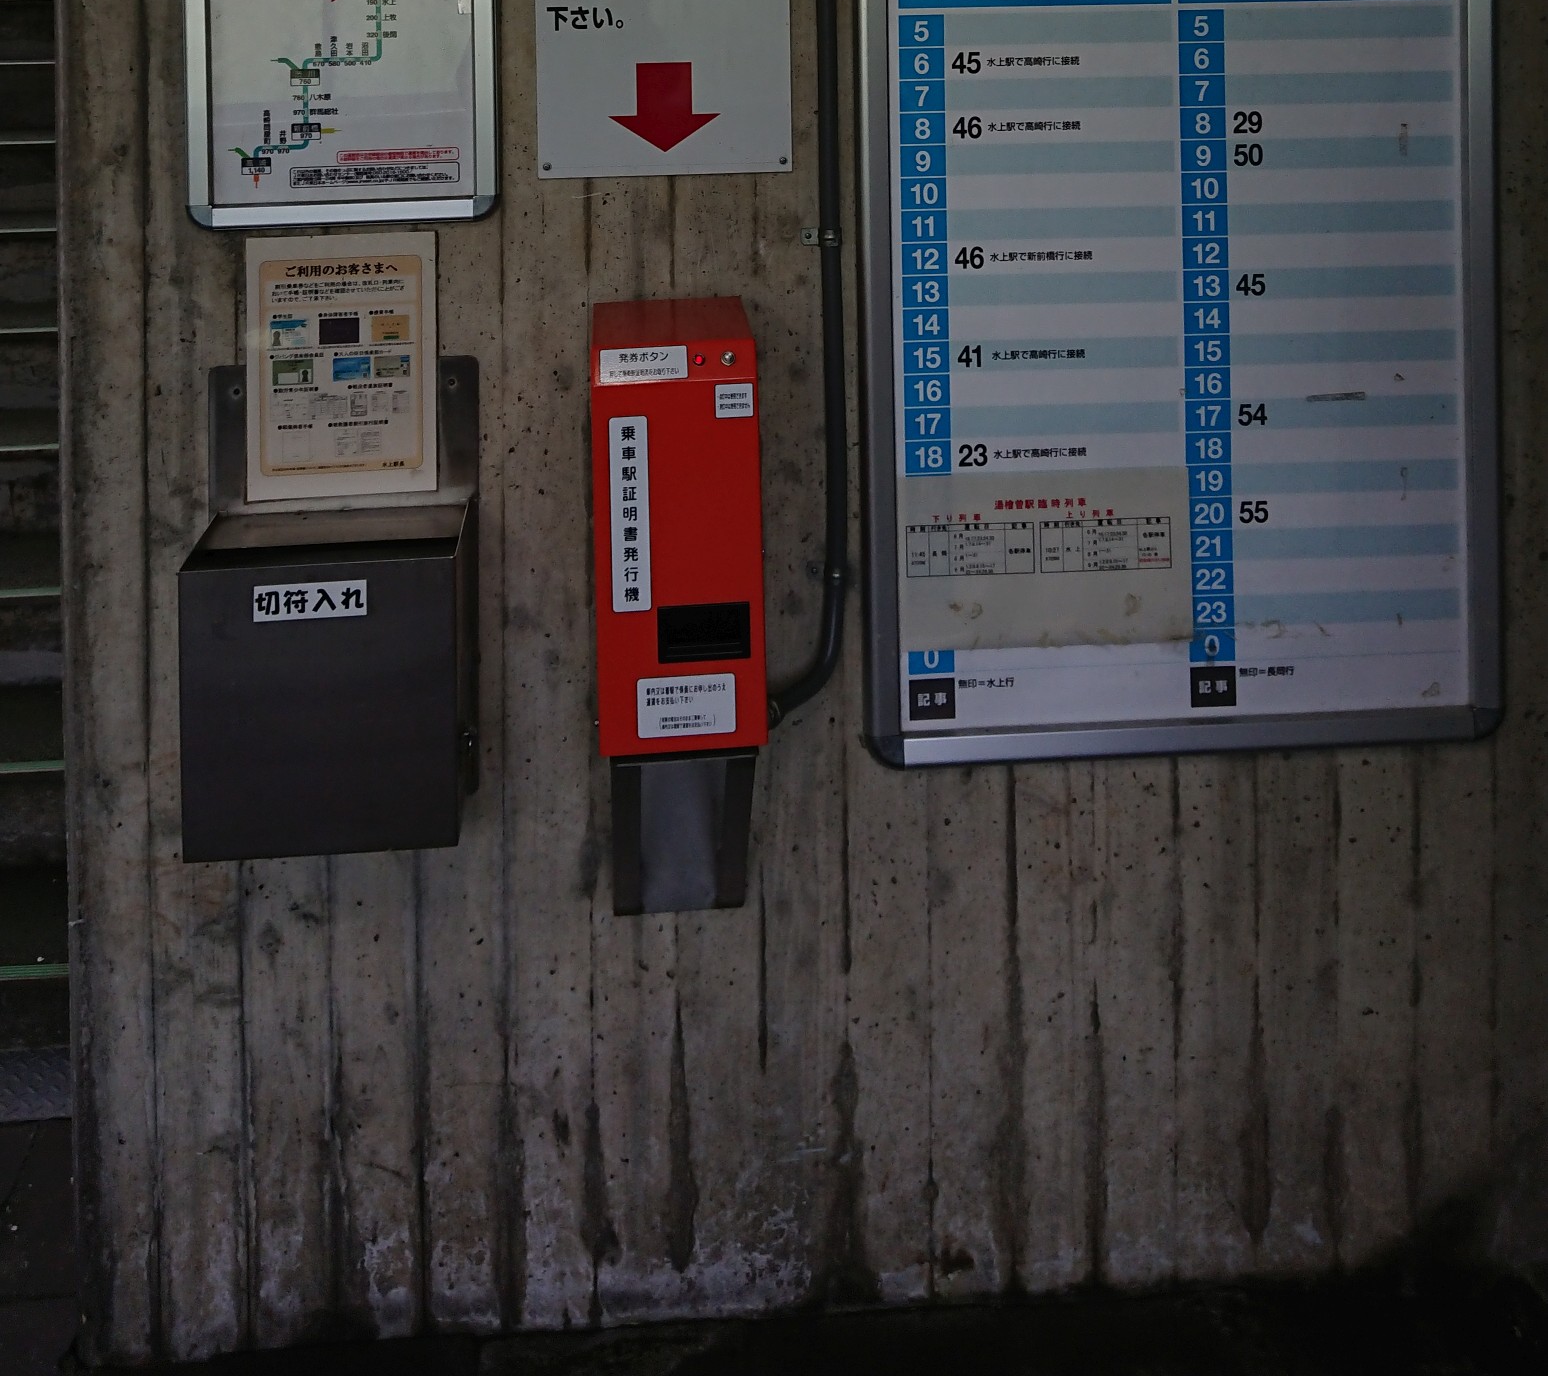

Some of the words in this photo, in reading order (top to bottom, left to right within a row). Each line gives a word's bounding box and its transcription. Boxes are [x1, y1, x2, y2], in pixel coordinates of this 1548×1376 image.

[546, 6, 624, 31] 下さい。
[1194, 16, 1208, 36] 5
[914, 21, 929, 41] 5
[915, 54, 929, 74] 6
[952, 52, 981, 74] 45
[1194, 48, 1209, 69] 6
[915, 86, 929, 106] 7
[1195, 81, 1209, 101] 7
[915, 118, 930, 139] 8
[953, 116, 982, 139] 46
[1196, 113, 1210, 134] 8
[1234, 111, 1262, 133] 29
[916, 151, 930, 171] 9
[1196, 146, 1211, 166] 9
[1234, 144, 1263, 166] 50
[911, 183, 938, 204] 10
[1192, 178, 1218, 198] 10
[912, 216, 934, 236] 11
[1193, 211, 1214, 231] 11
[912, 249, 939, 269] 12
[955, 246, 984, 269] 46
[1193, 243, 1220, 263] 12
[285, 262, 398, 277] ご利用のお客さまへ
[913, 281, 940, 302] 13
[1194, 276, 1220, 296] 13
[1236, 274, 1265, 296] 45
[913, 314, 940, 335] 14
[1194, 308, 1221, 328] 14
[618, 352, 669, 363] 発券ボタン
[914, 347, 941, 368] 15
[958, 345, 981, 367] 41
[1195, 341, 1221, 361] 15
[914, 380, 941, 401] 16
[1195, 373, 1222, 394] 16
[915, 414, 941, 434] 17
[1196, 406, 1221, 426] 17
[1238, 404, 1267, 426] 54
[916, 446, 942, 467] 18
[959, 444, 987, 467] 23
[1196, 438, 1222, 458] 18
[1196, 471, 1223, 491] 19
[621, 426, 640, 603] 乗車駅証明書発行機
[1195, 503, 1225, 524] 20
[1240, 501, 1268, 523] 55
[1196, 536, 1220, 557] 21
[1196, 568, 1226, 590] 22
[255, 587, 364, 615] 切符入れ
[1197, 602, 1226, 622] 23
